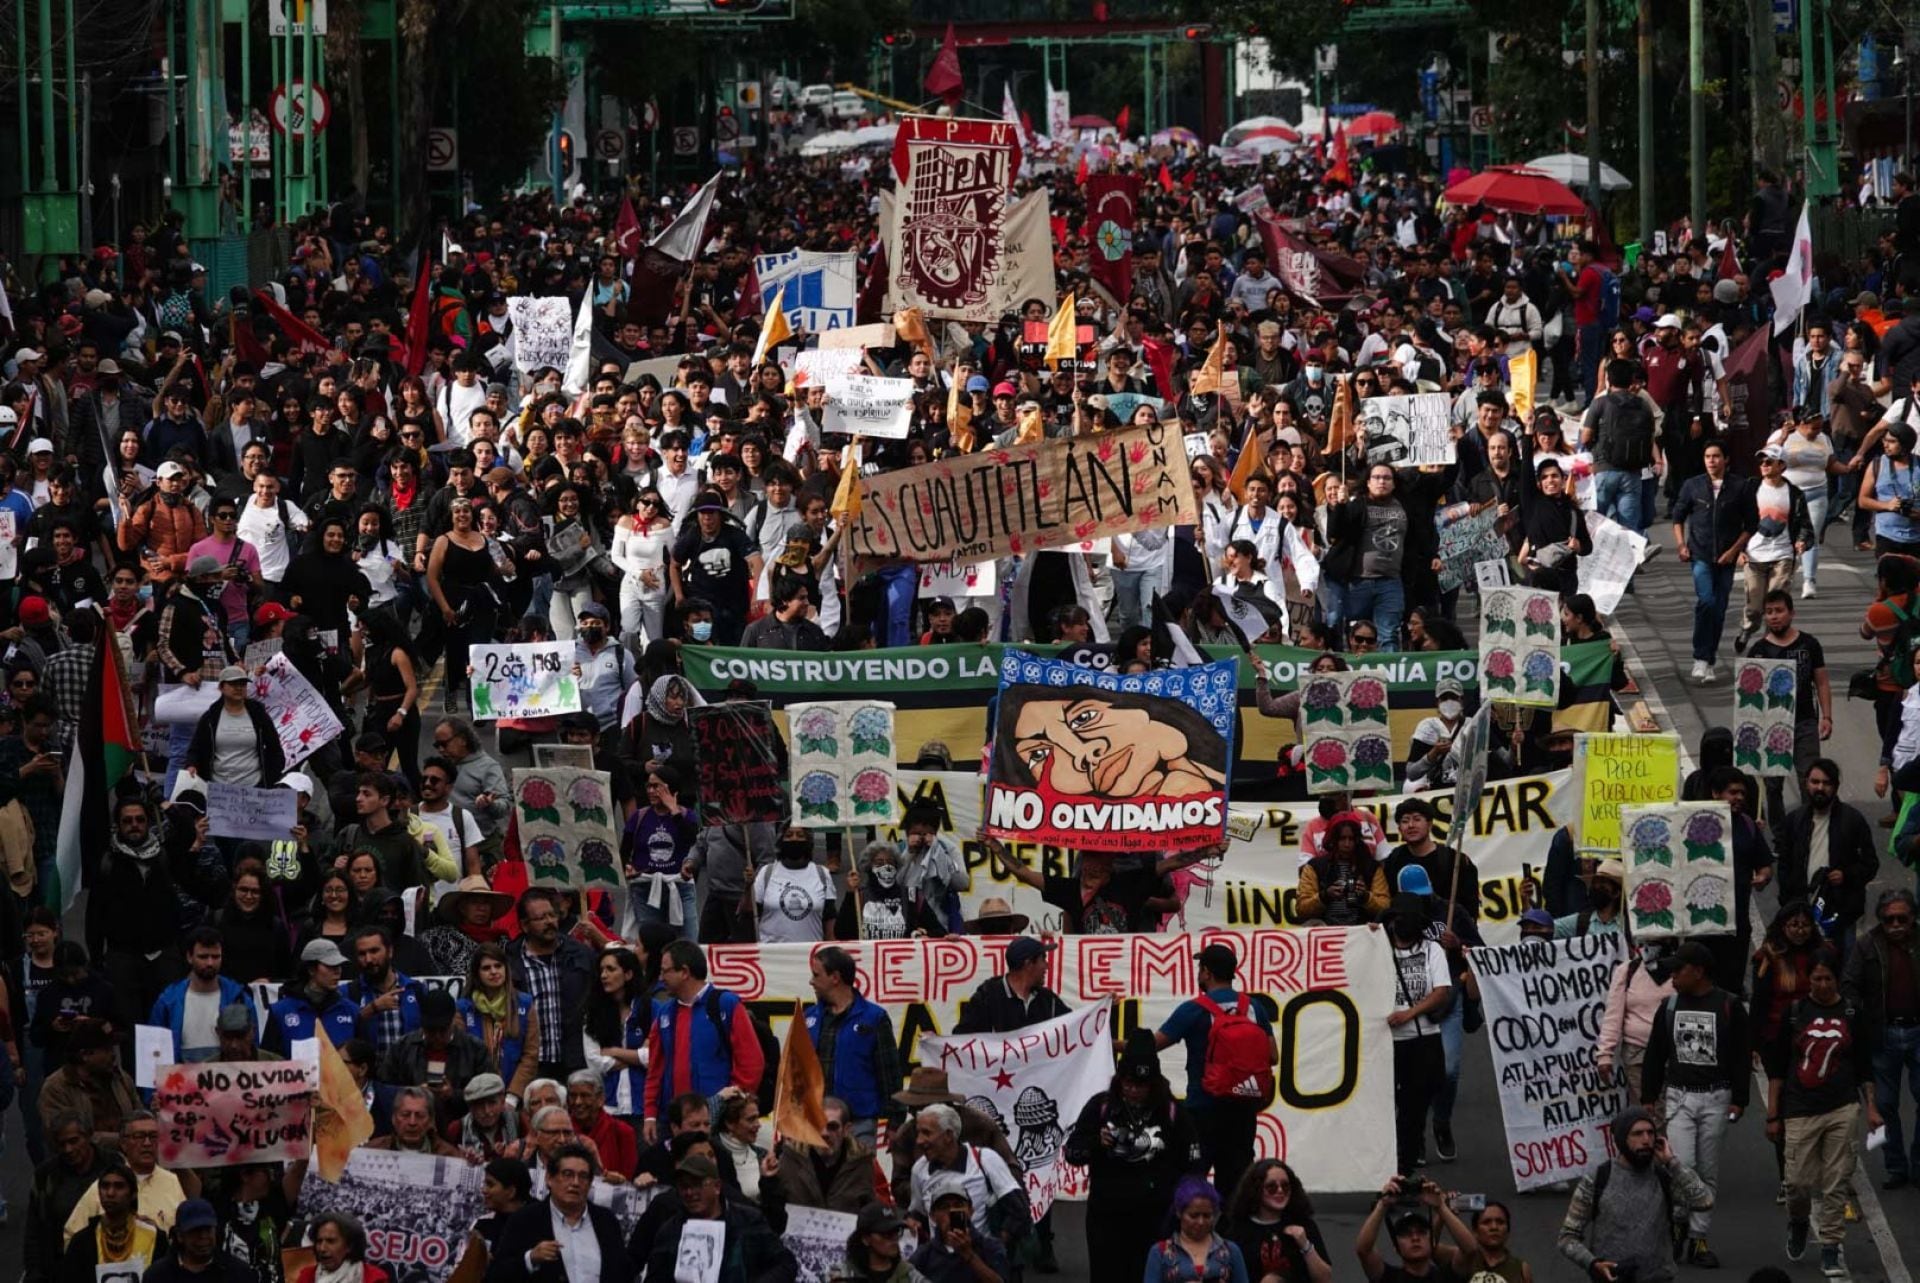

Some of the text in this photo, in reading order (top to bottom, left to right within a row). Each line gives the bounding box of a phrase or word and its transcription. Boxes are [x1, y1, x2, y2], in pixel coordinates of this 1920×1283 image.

[757, 251, 798, 274] IPN
[900, 442, 1133, 551] CUAUTITLÁN
[485, 652, 503, 683] 2
[710, 657, 950, 682] CONSTRUYENDO
[958, 655, 998, 678] LA
[1593, 735, 1655, 758] LUCHAR
[989, 787, 1044, 830] NO
[1051, 795, 1222, 832] OLVIDAMOS
[1470, 932, 1619, 977] HOMBRO CON
[940, 1007, 1108, 1071] ATLAPULCO
[1493, 1013, 1560, 1054] CODO
[197, 1069, 231, 1092] NO
[170, 1128, 195, 1143] 24
[1514, 1129, 1588, 1178] SOMOS
